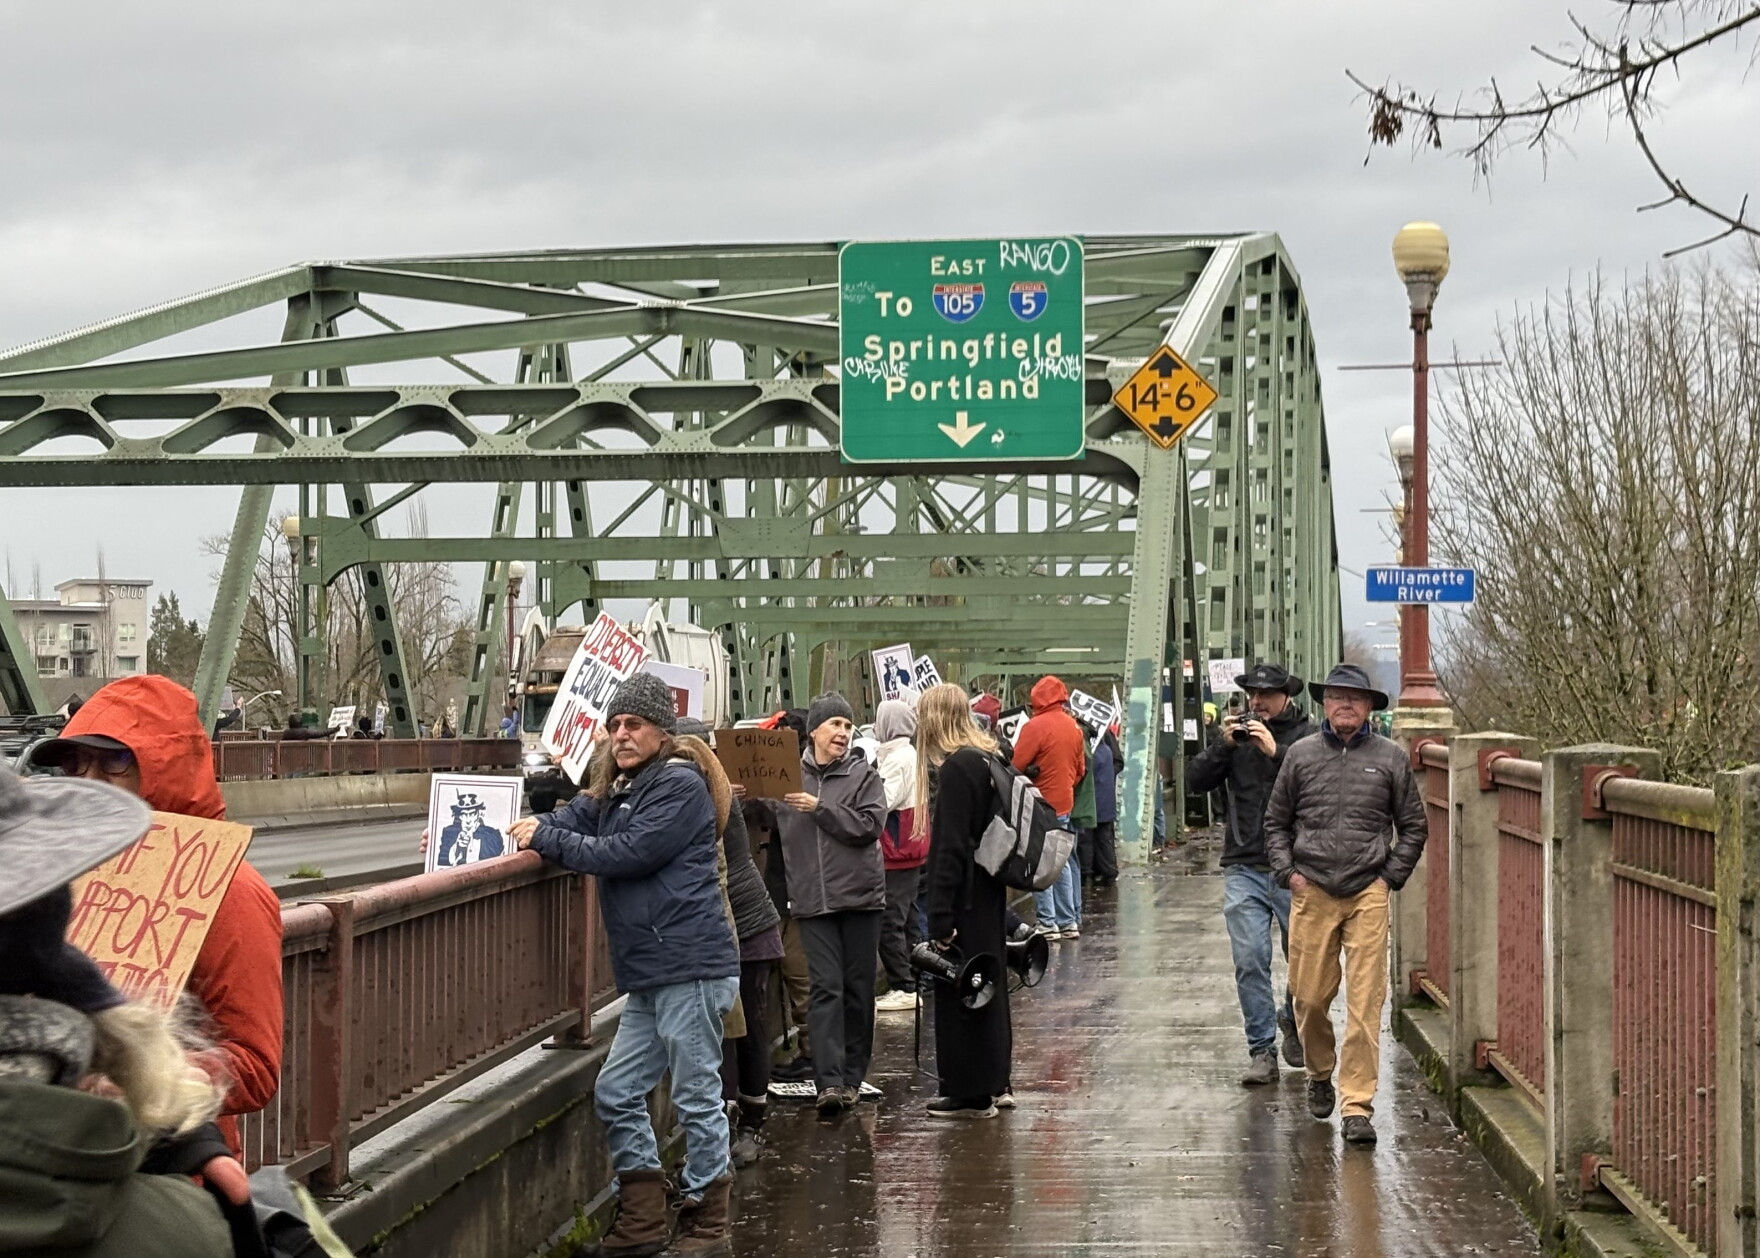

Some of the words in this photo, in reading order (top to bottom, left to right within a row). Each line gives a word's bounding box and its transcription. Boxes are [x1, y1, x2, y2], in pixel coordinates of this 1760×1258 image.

[931, 256, 986, 275] EAST
[1000, 240, 1070, 275] RANGO
[875, 291, 913, 317] To
[943, 293, 975, 315] 105
[1022, 292, 1036, 315] 5
[864, 332, 1062, 368] Springfield
[886, 374, 1039, 401] Portland
[1376, 570, 1465, 586] Willamette
[1397, 586, 1442, 601] River
[583, 614, 651, 675] DIVERSITY
[570, 657, 622, 714] EQUALIT
[1072, 692, 1112, 721] US
[552, 700, 598, 765] UNITY
[735, 735, 784, 748] CHINGA
[738, 767, 790, 782] MIGRA
[156, 827, 243, 900] YOU
[69, 880, 208, 969] PPORT
